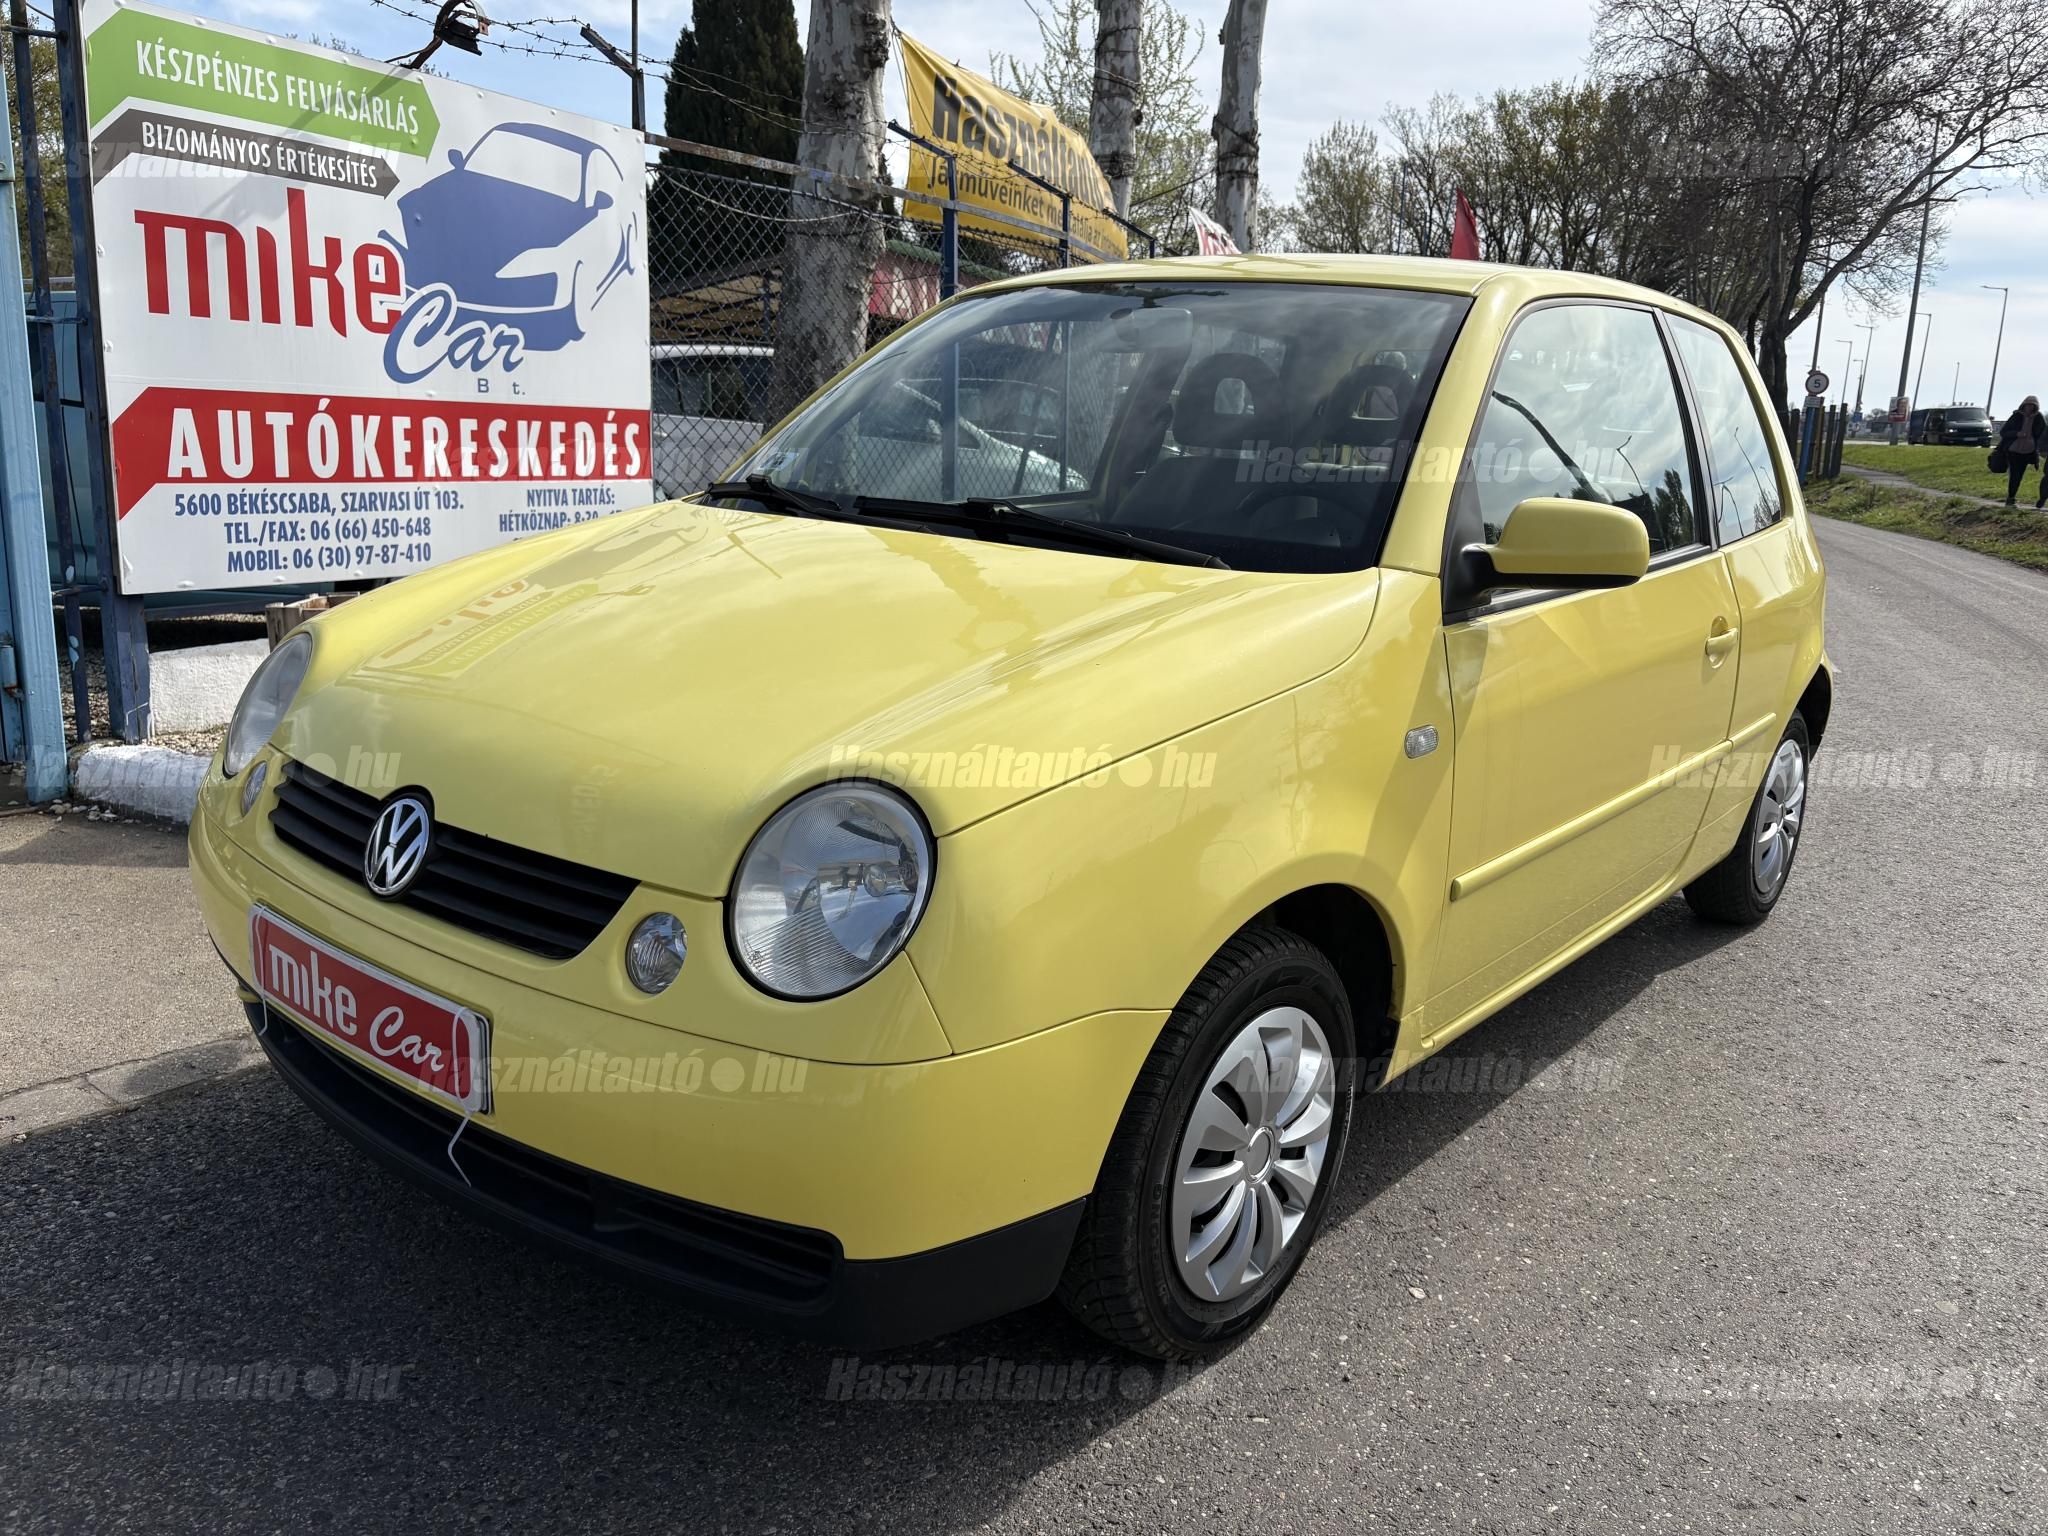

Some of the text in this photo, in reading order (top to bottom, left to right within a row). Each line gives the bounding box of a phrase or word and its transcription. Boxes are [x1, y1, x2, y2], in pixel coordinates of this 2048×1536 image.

[136, 37, 419, 136] KÉSZPÉNZES FELVÁSÁRLÁS
[141, 121, 378, 189] BIZOMÁNYOS ÉRTÉKESÍTÉS
[928, 157, 1045, 215] Jáműveinket
[134, 187, 405, 339] mike
[382, 282, 526, 385] Car
[1814, 379, 1821, 388] 5
[166, 398, 641, 479] AUTÓKERESKEDÉS
[175, 486, 464, 517] 5600 BÉKÉSCSABA, SZARVASI ÚT 103.
[499, 509, 571, 532] HÉTKÖZNAP:
[527, 485, 615, 507] NYITVA TARTÁS:
[225, 516, 431, 546] TEL./FAX: 06 (66) 450-648
[228, 542, 432, 574] MOBIL: 06 (30) 97-87-410
[268, 943, 445, 1073] mike Car
